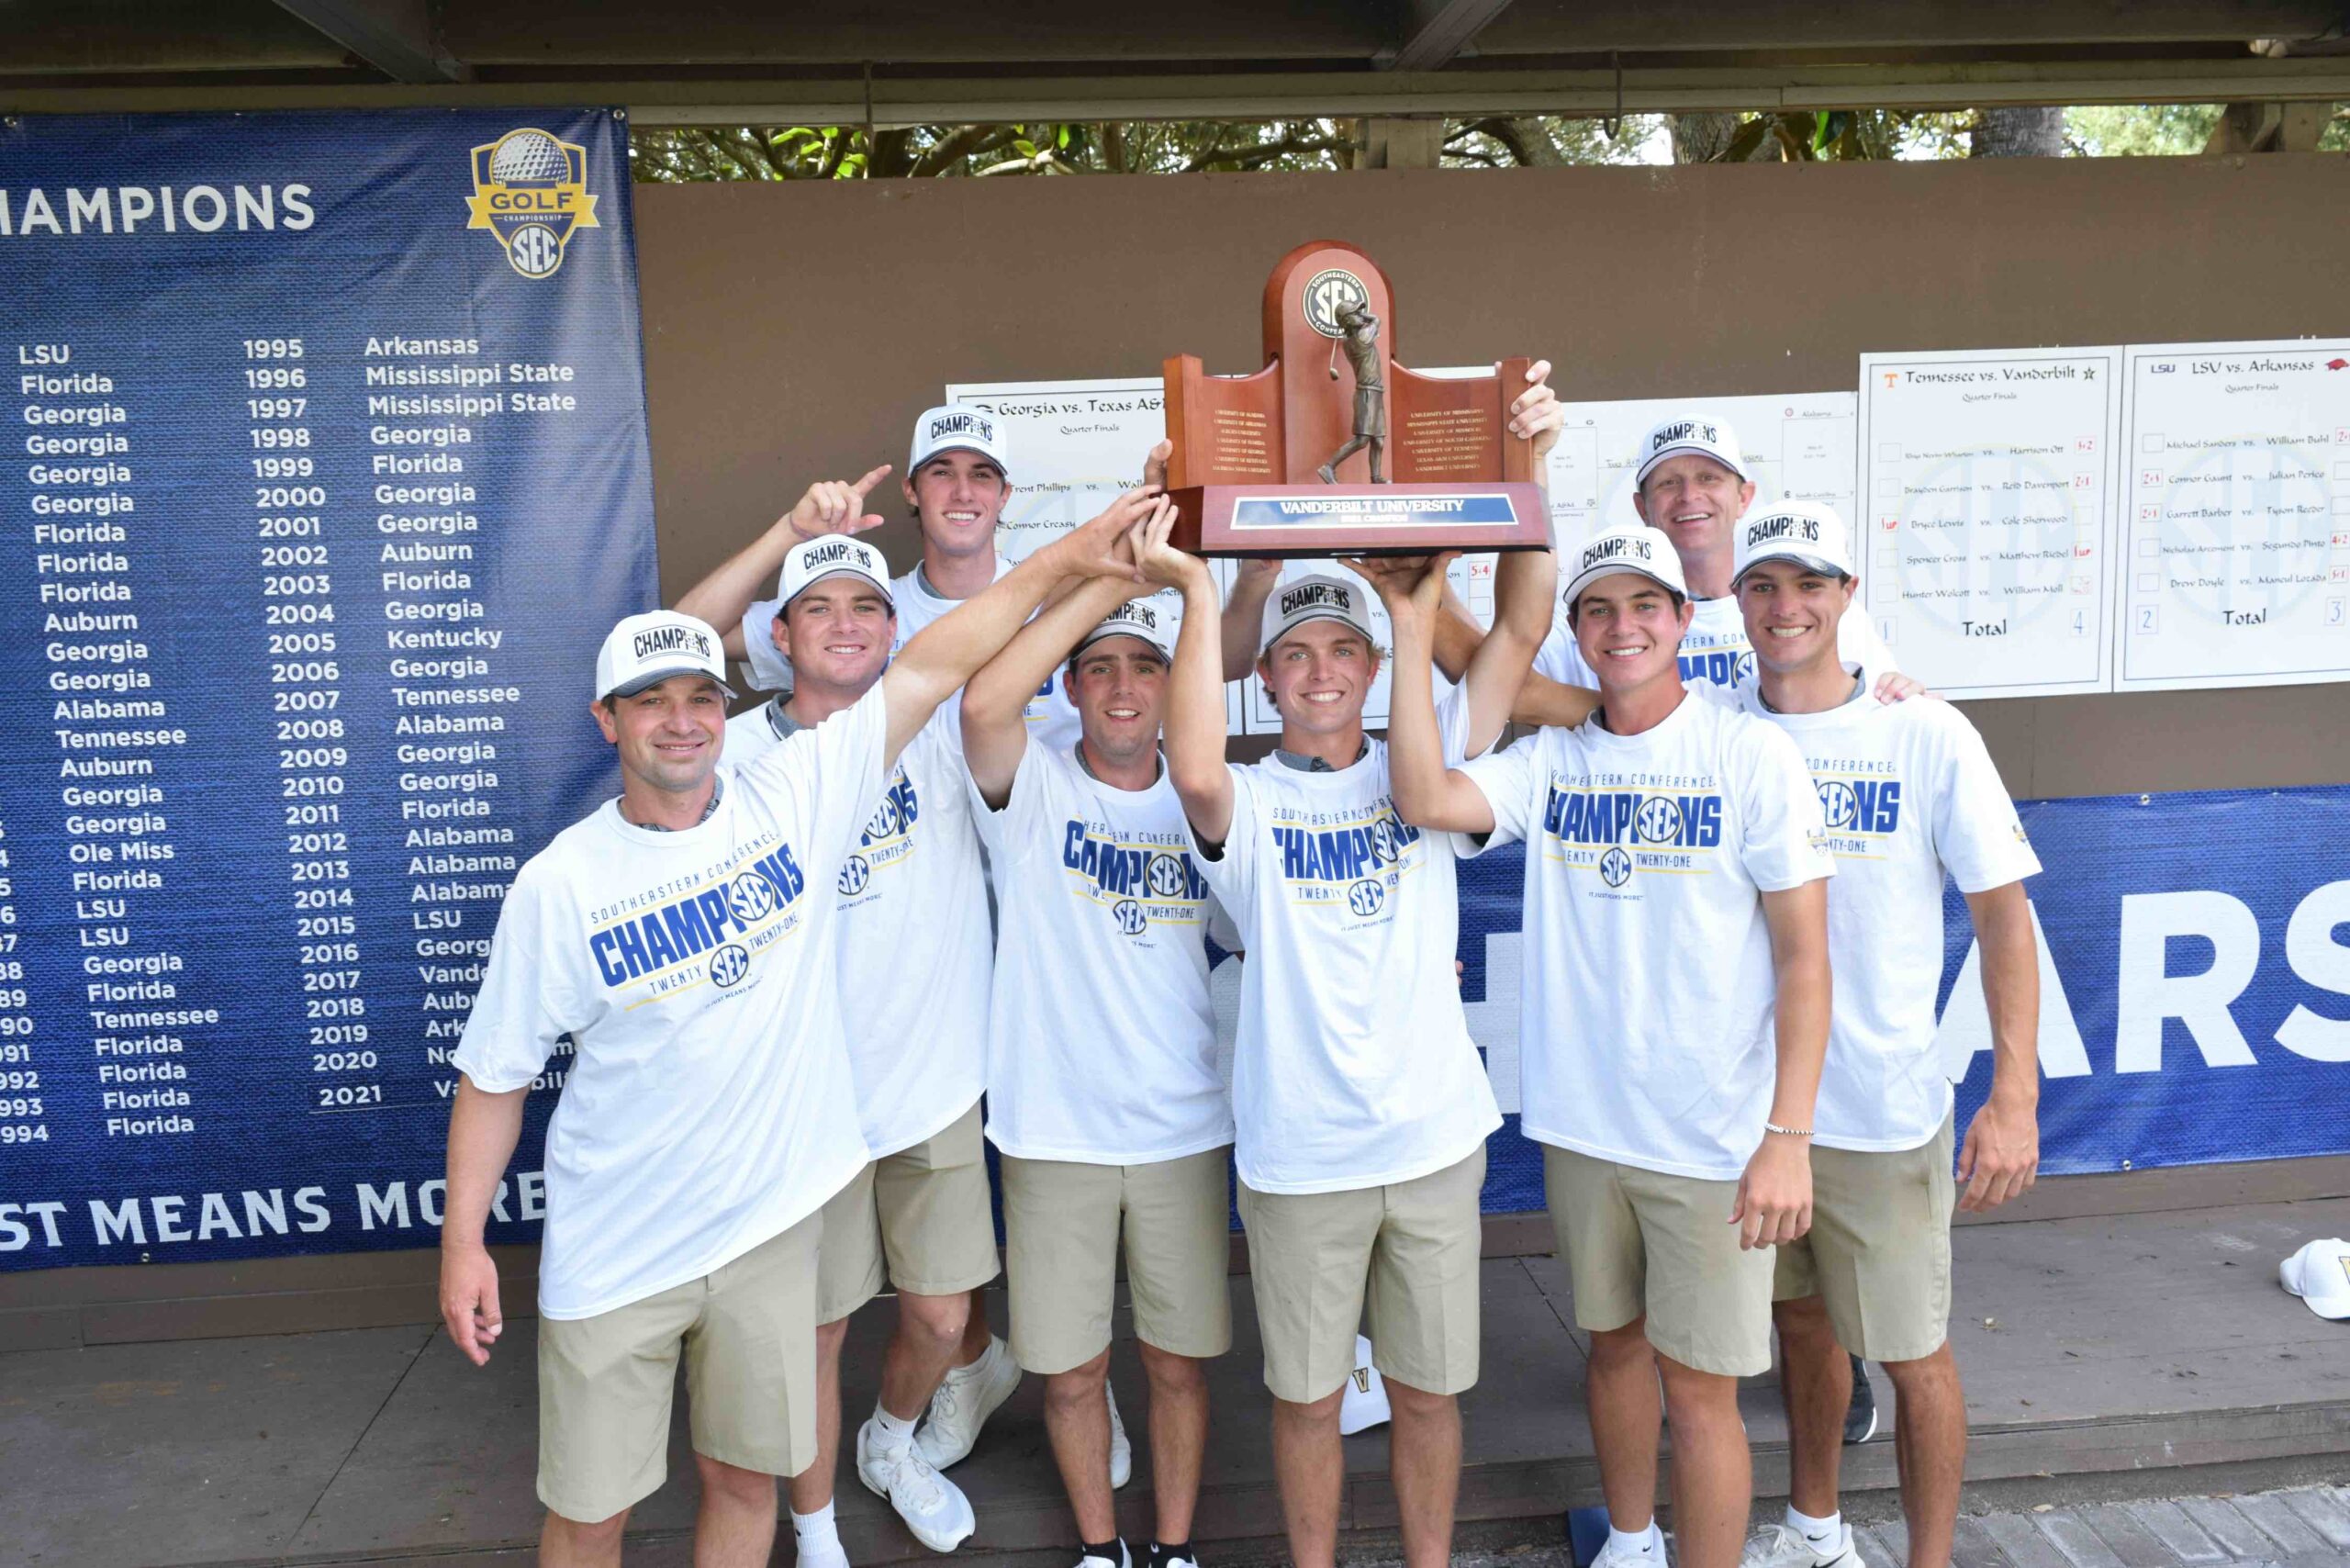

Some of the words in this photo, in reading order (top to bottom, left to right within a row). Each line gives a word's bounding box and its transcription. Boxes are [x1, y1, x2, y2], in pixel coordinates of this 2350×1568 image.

[490, 192, 573, 210] GOLF
[503, 214, 563, 222] CHAMPIONSHIP
[512, 228, 557, 273] SEC
[1311, 271, 1361, 288] SOUTHEASTERN
[18, 344, 70, 364] LSU
[242, 338, 304, 359] 1995
[364, 334, 479, 356] Arkansas
[244, 367, 307, 389] 1996
[365, 364, 502, 388] Mississippi
[509, 363, 575, 383] State
[1905, 370, 1975, 384] Tennessee
[1979, 371, 1998, 382] vs.
[2002, 365, 2076, 382] Vanderbilt
[2151, 364, 2177, 375] LSU
[2225, 363, 2245, 374] vs.
[2248, 358, 2316, 374] Arkansas
[20, 372, 114, 395] Florida
[1885, 373, 1898, 388] T
[2224, 384, 2255, 394] Quarter
[2256, 383, 2280, 392] Finals
[247, 398, 308, 419] 1997
[367, 394, 504, 419] Mississippi
[510, 392, 576, 412] State
[998, 402, 1058, 419] Georgia
[1060, 403, 1083, 414] vs.
[1087, 398, 1133, 413] Texas
[1962, 393, 1992, 403] Quarter
[1993, 392, 2018, 400] Finals
[23, 402, 127, 427] Georgia
[250, 427, 311, 449] 1998
[370, 425, 472, 447] Georgia
[930, 415, 993, 442] CHAMPIONS
[1060, 425, 1092, 435] Quarter
[1093, 423, 1120, 433] Finals
[1652, 423, 1717, 451] CHAMPIONS
[25, 434, 129, 457] Georgia
[2009, 445, 2049, 456] Harrison
[2050, 444, 2065, 454] Ott
[2266, 436, 2306, 447] William
[28, 465, 132, 487] Georgia
[252, 456, 314, 478] 1999
[372, 453, 464, 475] Florida
[1036, 483, 1071, 494] Phillips
[1086, 483, 1100, 491] vs.
[2024, 480, 2071, 491] Davenport
[2168, 475, 2202, 485] Connor
[30, 494, 135, 517] Georgia
[255, 486, 326, 508] 2000
[375, 482, 476, 506] Georgia
[1280, 499, 1375, 515] VANDERBILT
[1377, 498, 1465, 514] UNIVERSITY
[258, 516, 320, 537] 2001
[377, 511, 478, 535] Georgia
[1006, 520, 1041, 531] Connor
[1043, 519, 1077, 530] Creasy
[2166, 509, 2199, 520] Garrett
[2201, 507, 2232, 518] Barber
[33, 521, 127, 544] Florida
[1747, 517, 1819, 547] CHAMPIONS
[37, 551, 129, 574] Florida
[261, 544, 329, 567] 2002
[380, 542, 473, 563] Auburn
[802, 543, 872, 571] CHAMPIONS
[1583, 538, 1651, 569] CHAMPIONS
[1998, 550, 2042, 561] Matthew
[39, 580, 132, 603] Florida
[263, 575, 330, 596] 2003
[382, 569, 472, 592] Florida
[1902, 589, 1933, 599] Hunter
[2003, 586, 2042, 596] William
[2042, 583, 2065, 594] Moll
[265, 603, 336, 625] 2004
[385, 598, 484, 622] Georgia
[1281, 585, 1350, 615] CHAMPIONS
[2331, 600, 2342, 622] 3
[43, 610, 139, 633] Auburn
[1961, 618, 2009, 637] Total
[2074, 610, 2086, 635] 4
[2142, 610, 2153, 630] 2
[2222, 607, 2267, 626] Total
[46, 639, 149, 664] Georgia
[268, 633, 337, 655] 2005
[387, 626, 503, 650] Kentucky
[633, 628, 711, 659] CHAMPIONS
[49, 667, 151, 692] Georgia
[271, 661, 340, 683] 2006
[389, 655, 489, 680] Georgia
[274, 690, 341, 711] 2007
[391, 685, 520, 707] Tennessee
[53, 699, 166, 721] Alabama
[54, 728, 187, 749] Tennessee
[276, 718, 345, 741] 2008
[395, 713, 505, 735] Alabama
[279, 746, 348, 768] 2009
[397, 740, 497, 766] Georgia
[59, 756, 153, 778] Auburn
[282, 776, 344, 797] 2010
[398, 768, 499, 793] Georgia
[1630, 773, 1714, 789] CONFERENCE
[62, 783, 163, 808] Georgia
[285, 803, 340, 825] 2011
[401, 796, 491, 820] Florida
[65, 812, 167, 837] Georgia
[288, 832, 348, 854] 2012
[405, 825, 515, 848] Alabama
[69, 843, 111, 863] Ole
[120, 841, 175, 862] Miss
[1636, 853, 1692, 868] TWENTY-ONE
[73, 868, 163, 891] Florida
[291, 859, 350, 882] 2013
[407, 854, 517, 876] Alabama
[293, 888, 354, 909] 2014
[590, 873, 701, 924] SOUTHEASTERN
[1348, 879, 1384, 916] SEC
[75, 899, 127, 920] LSU
[589, 842, 805, 988] CHAMPIONS
[1113, 900, 1147, 935] SEC
[1147, 905, 1196, 919] TWENTY-ONE
[297, 915, 356, 937] 2015
[412, 909, 462, 930] LSU
[748, 911, 800, 951] TWENTY-ONE
[79, 926, 129, 947] LSU
[83, 951, 184, 975] Georgia
[299, 943, 360, 964] 2016
[711, 945, 749, 988] SEC
[86, 980, 176, 1002] Florida
[302, 970, 361, 991] 2017
[649, 965, 703, 995] TWENTY
[88, 1008, 219, 1029] Tennessee
[306, 997, 365, 1019] 2018
[95, 1034, 184, 1057] Florida
[309, 1024, 368, 1046] 2019
[98, 1060, 187, 1084] Florida
[312, 1050, 378, 1072] 2020
[102, 1087, 191, 1110] Florida
[319, 1084, 382, 1107] 2021
[106, 1114, 196, 1137] Florida
[89, 1186, 331, 1247] MEANS
[1352, 1367, 1370, 1394] V
